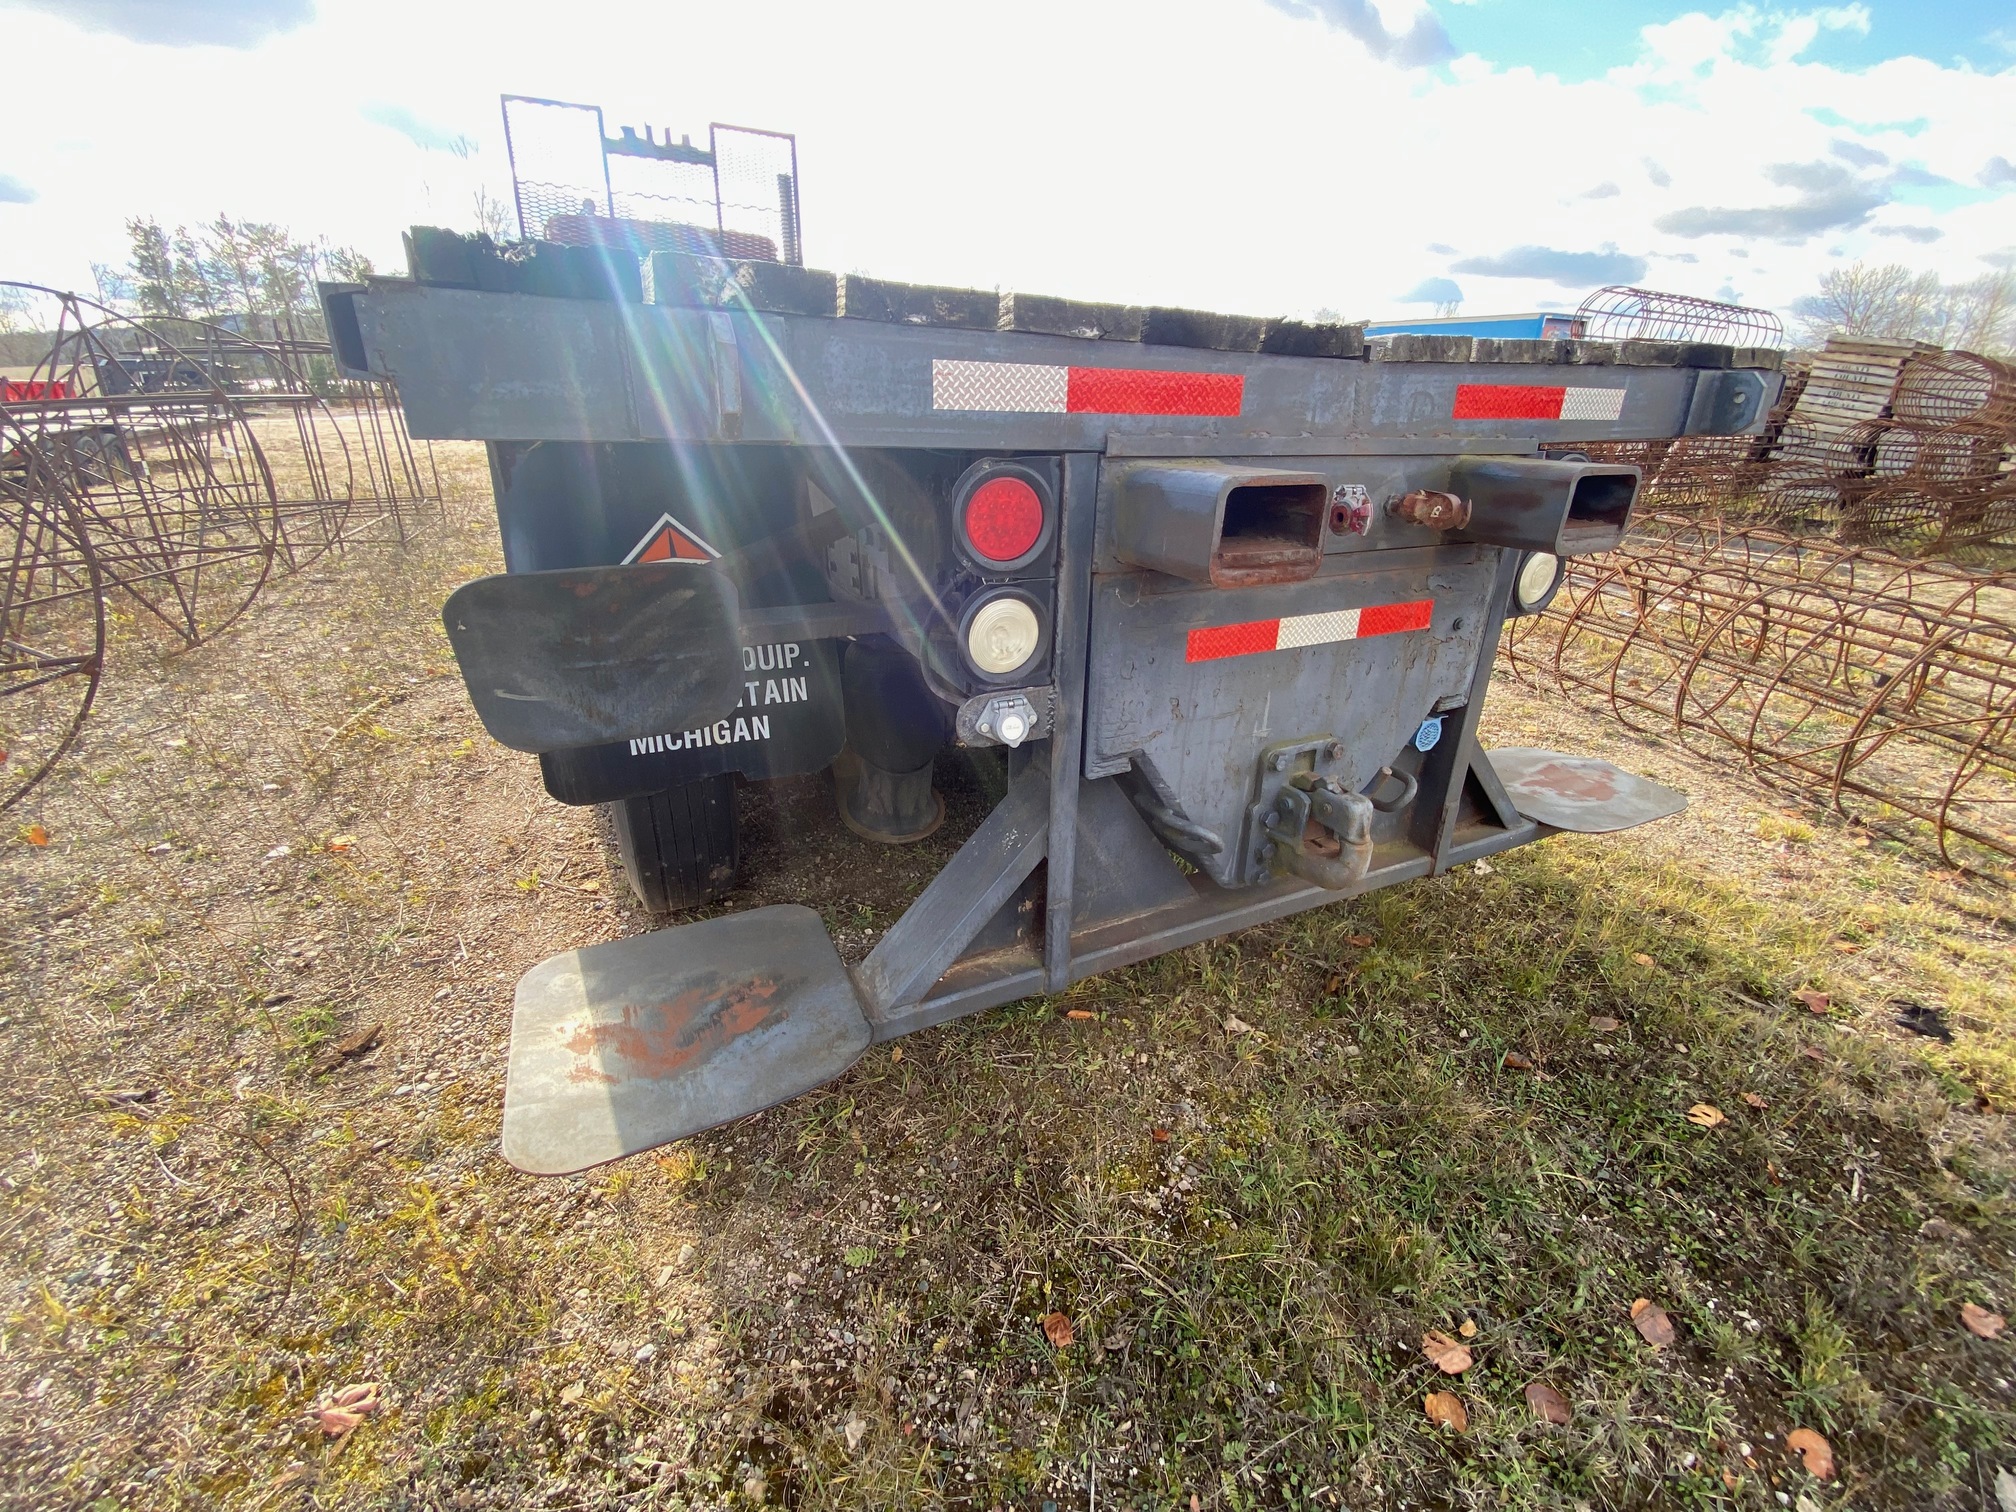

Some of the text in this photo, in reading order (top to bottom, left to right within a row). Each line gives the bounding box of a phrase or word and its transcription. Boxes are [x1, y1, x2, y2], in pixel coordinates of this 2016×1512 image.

[742, 643, 810, 671] QUIP.
[737, 676, 808, 708] TAIN
[629, 715, 771, 756] MICHIGAN
